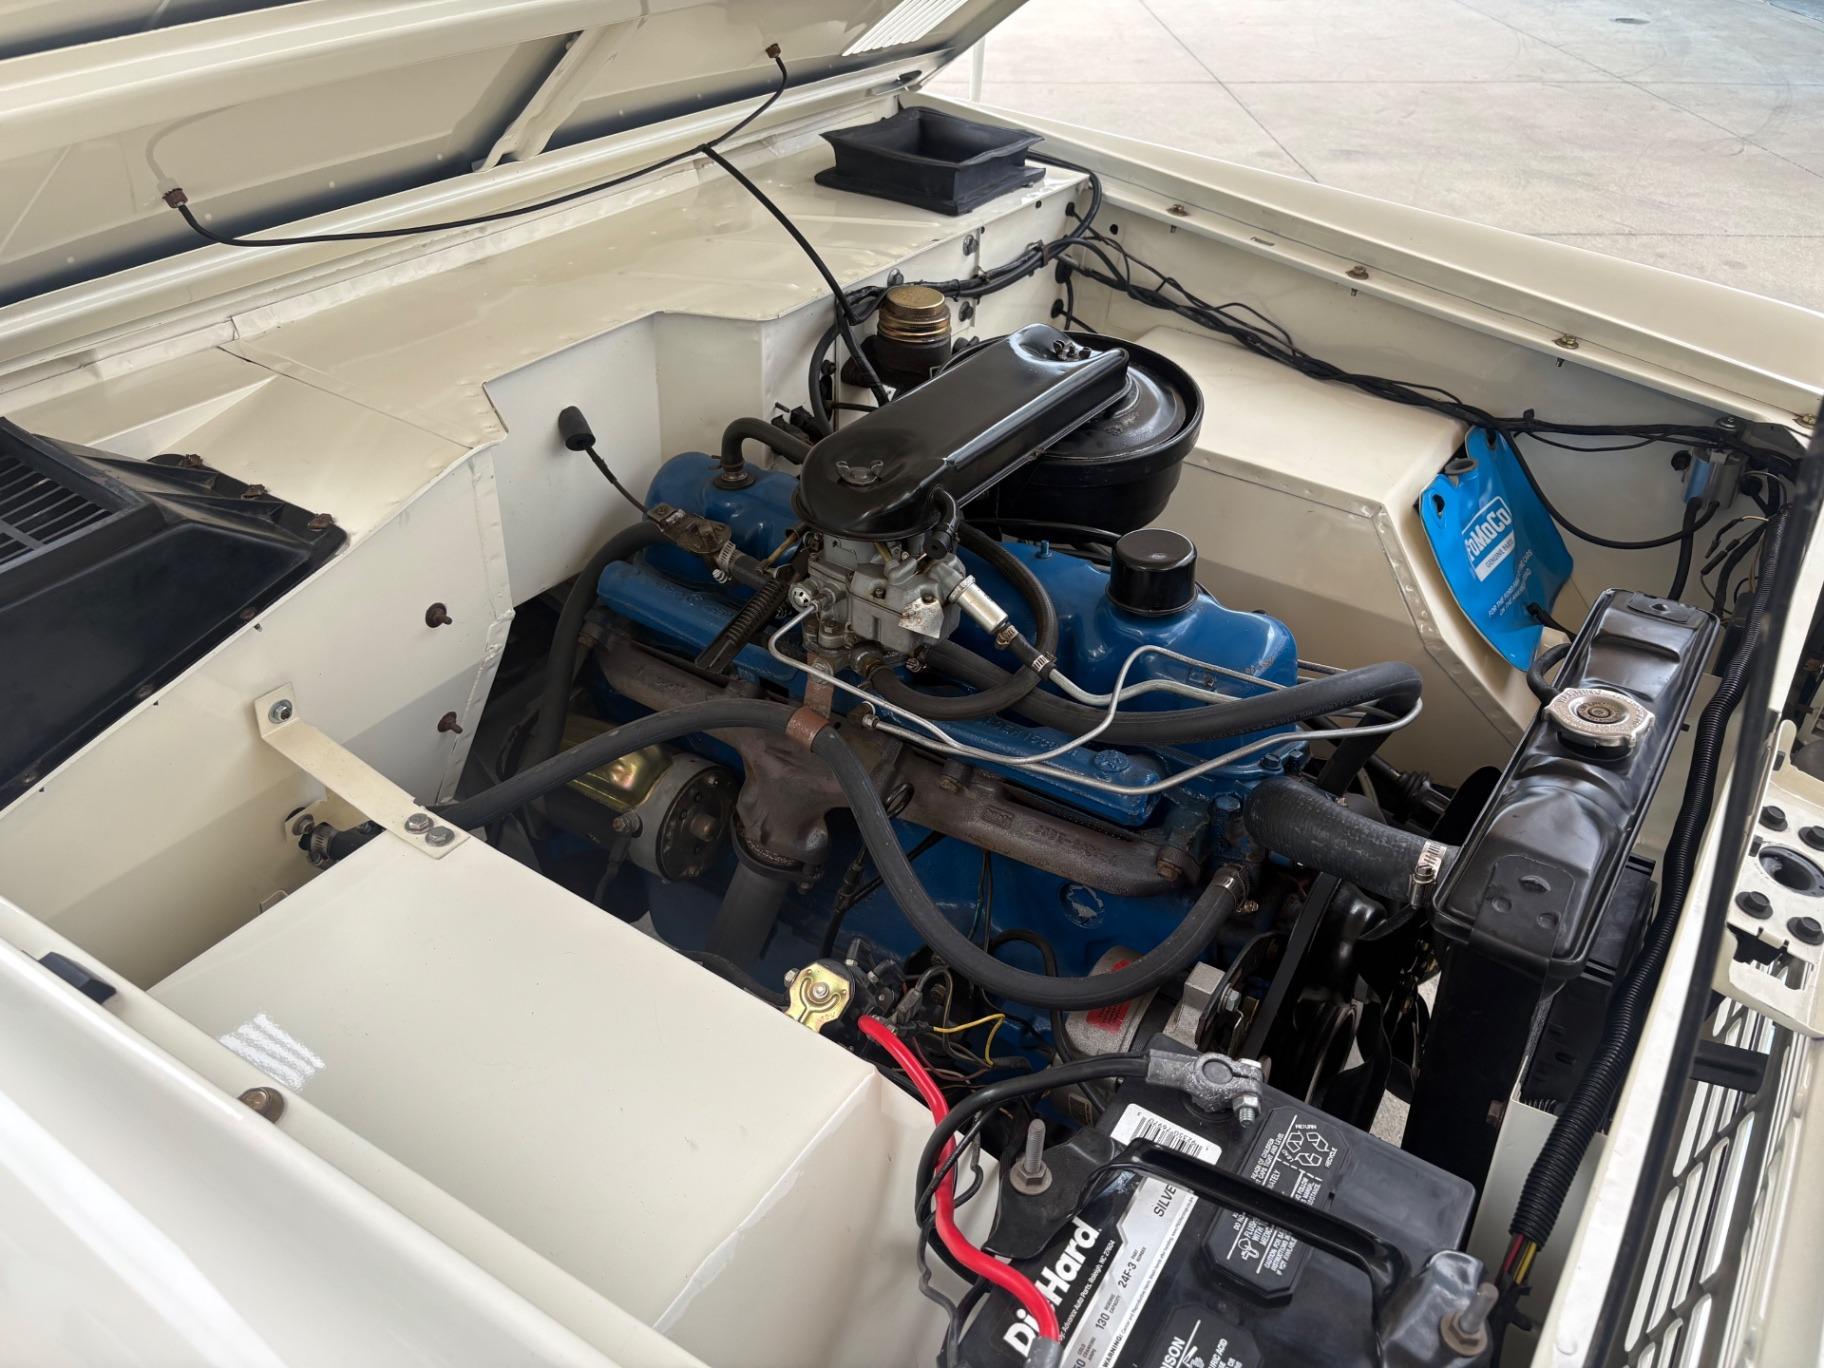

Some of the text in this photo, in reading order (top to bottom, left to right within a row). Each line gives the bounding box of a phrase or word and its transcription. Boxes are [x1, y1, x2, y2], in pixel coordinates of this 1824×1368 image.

[1464, 508, 1512, 561] FoMoCo
[1153, 1184, 1177, 1217] SILVE
[1003, 1216, 1099, 1358] DiHard
[1118, 1262, 1137, 1288] 24F-3
[1074, 1296, 1085, 1311] Auto
[1095, 1312, 1110, 1330] 130
[1160, 1336, 1185, 1368] ISON
[1215, 1338, 1228, 1356] ACID
